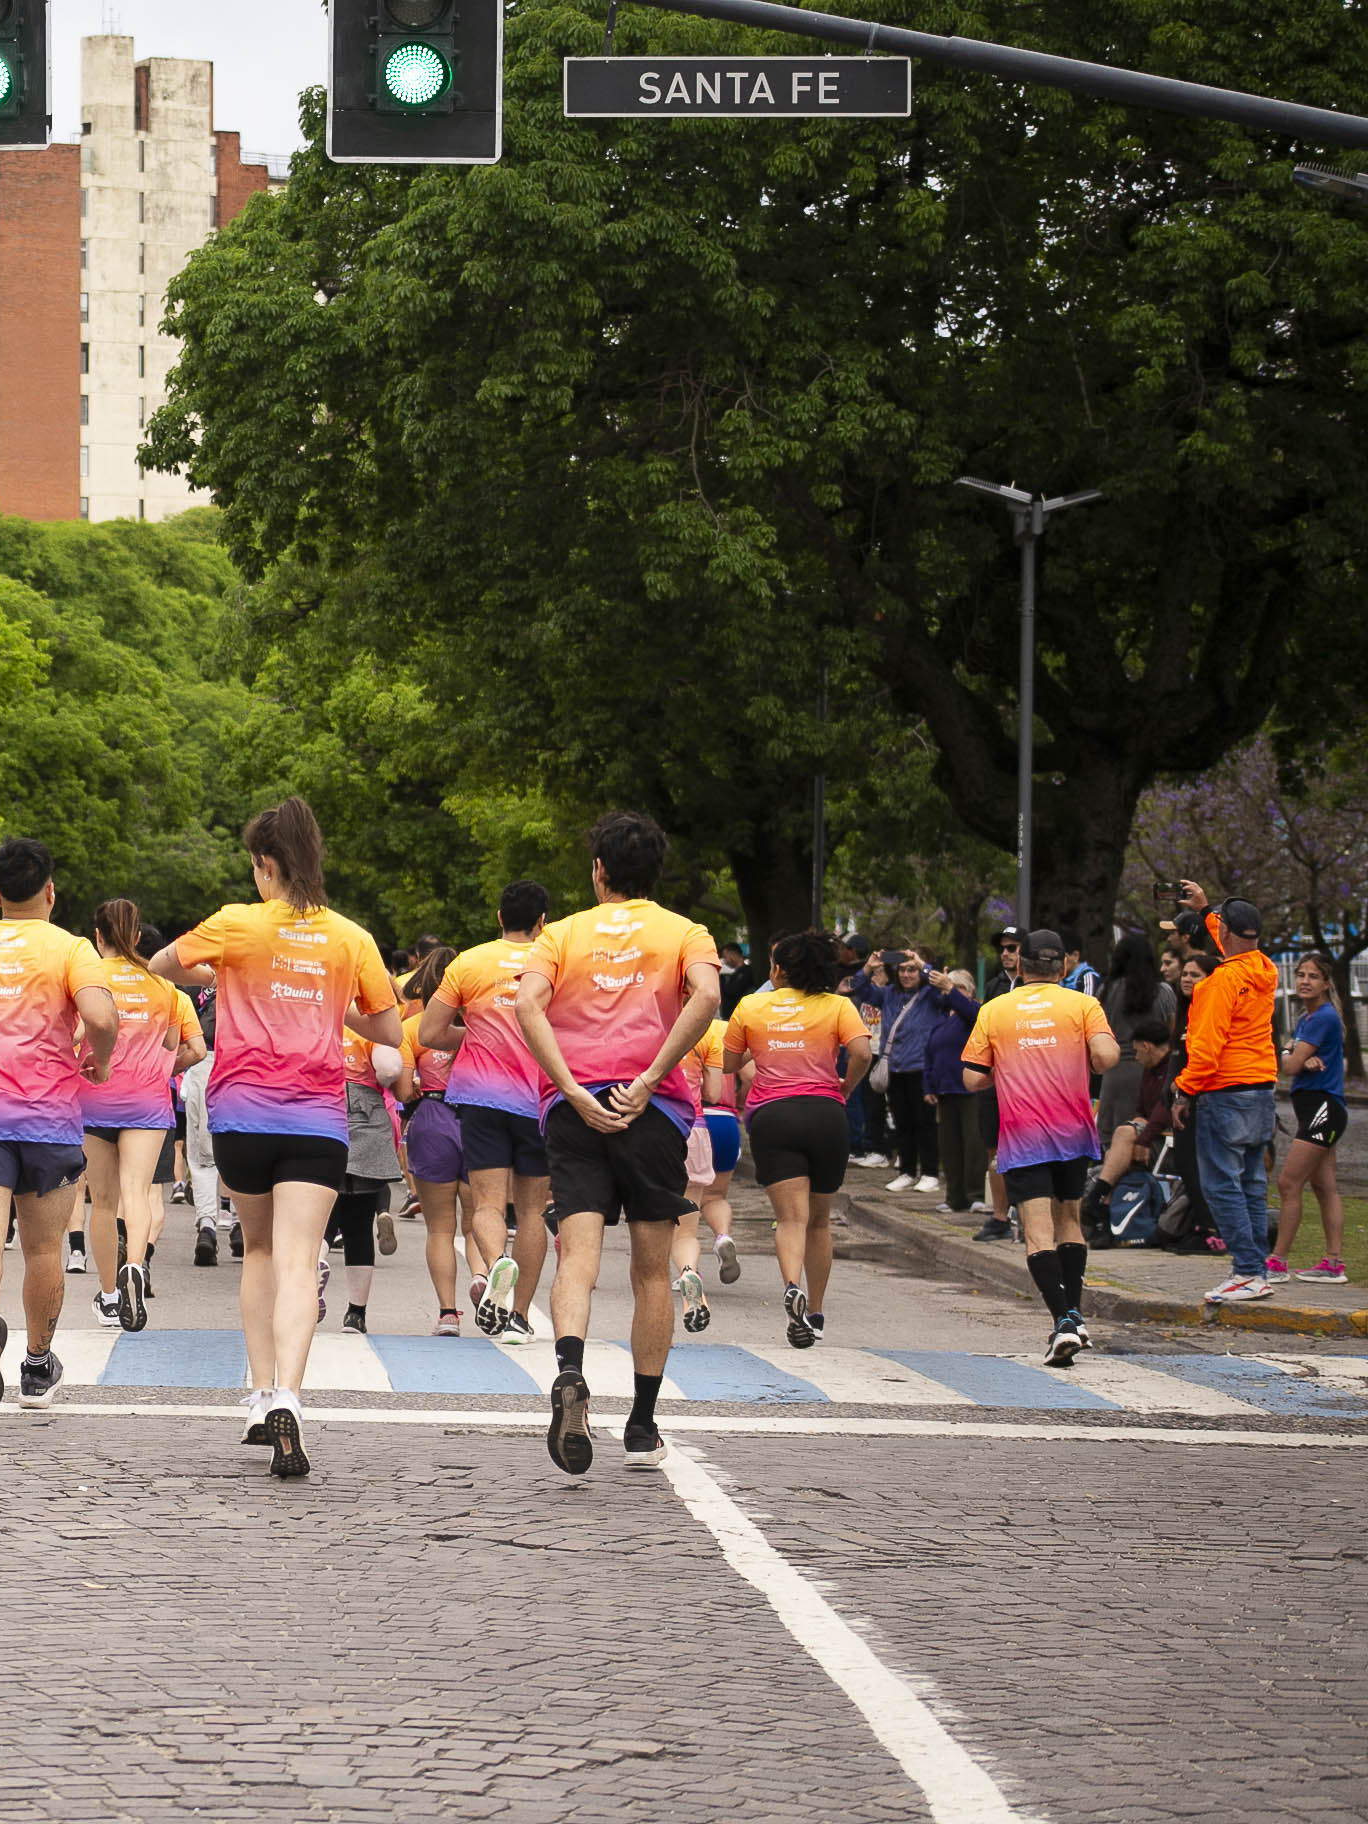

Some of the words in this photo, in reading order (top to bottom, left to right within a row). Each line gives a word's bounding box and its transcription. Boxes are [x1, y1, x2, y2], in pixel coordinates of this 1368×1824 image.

[638, 72, 775, 104] SANTA
[792, 72, 840, 104] FE
[278, 928, 312, 943] Santa
[313, 931, 328, 944] Fe
[315, 989, 324, 1001] 6
